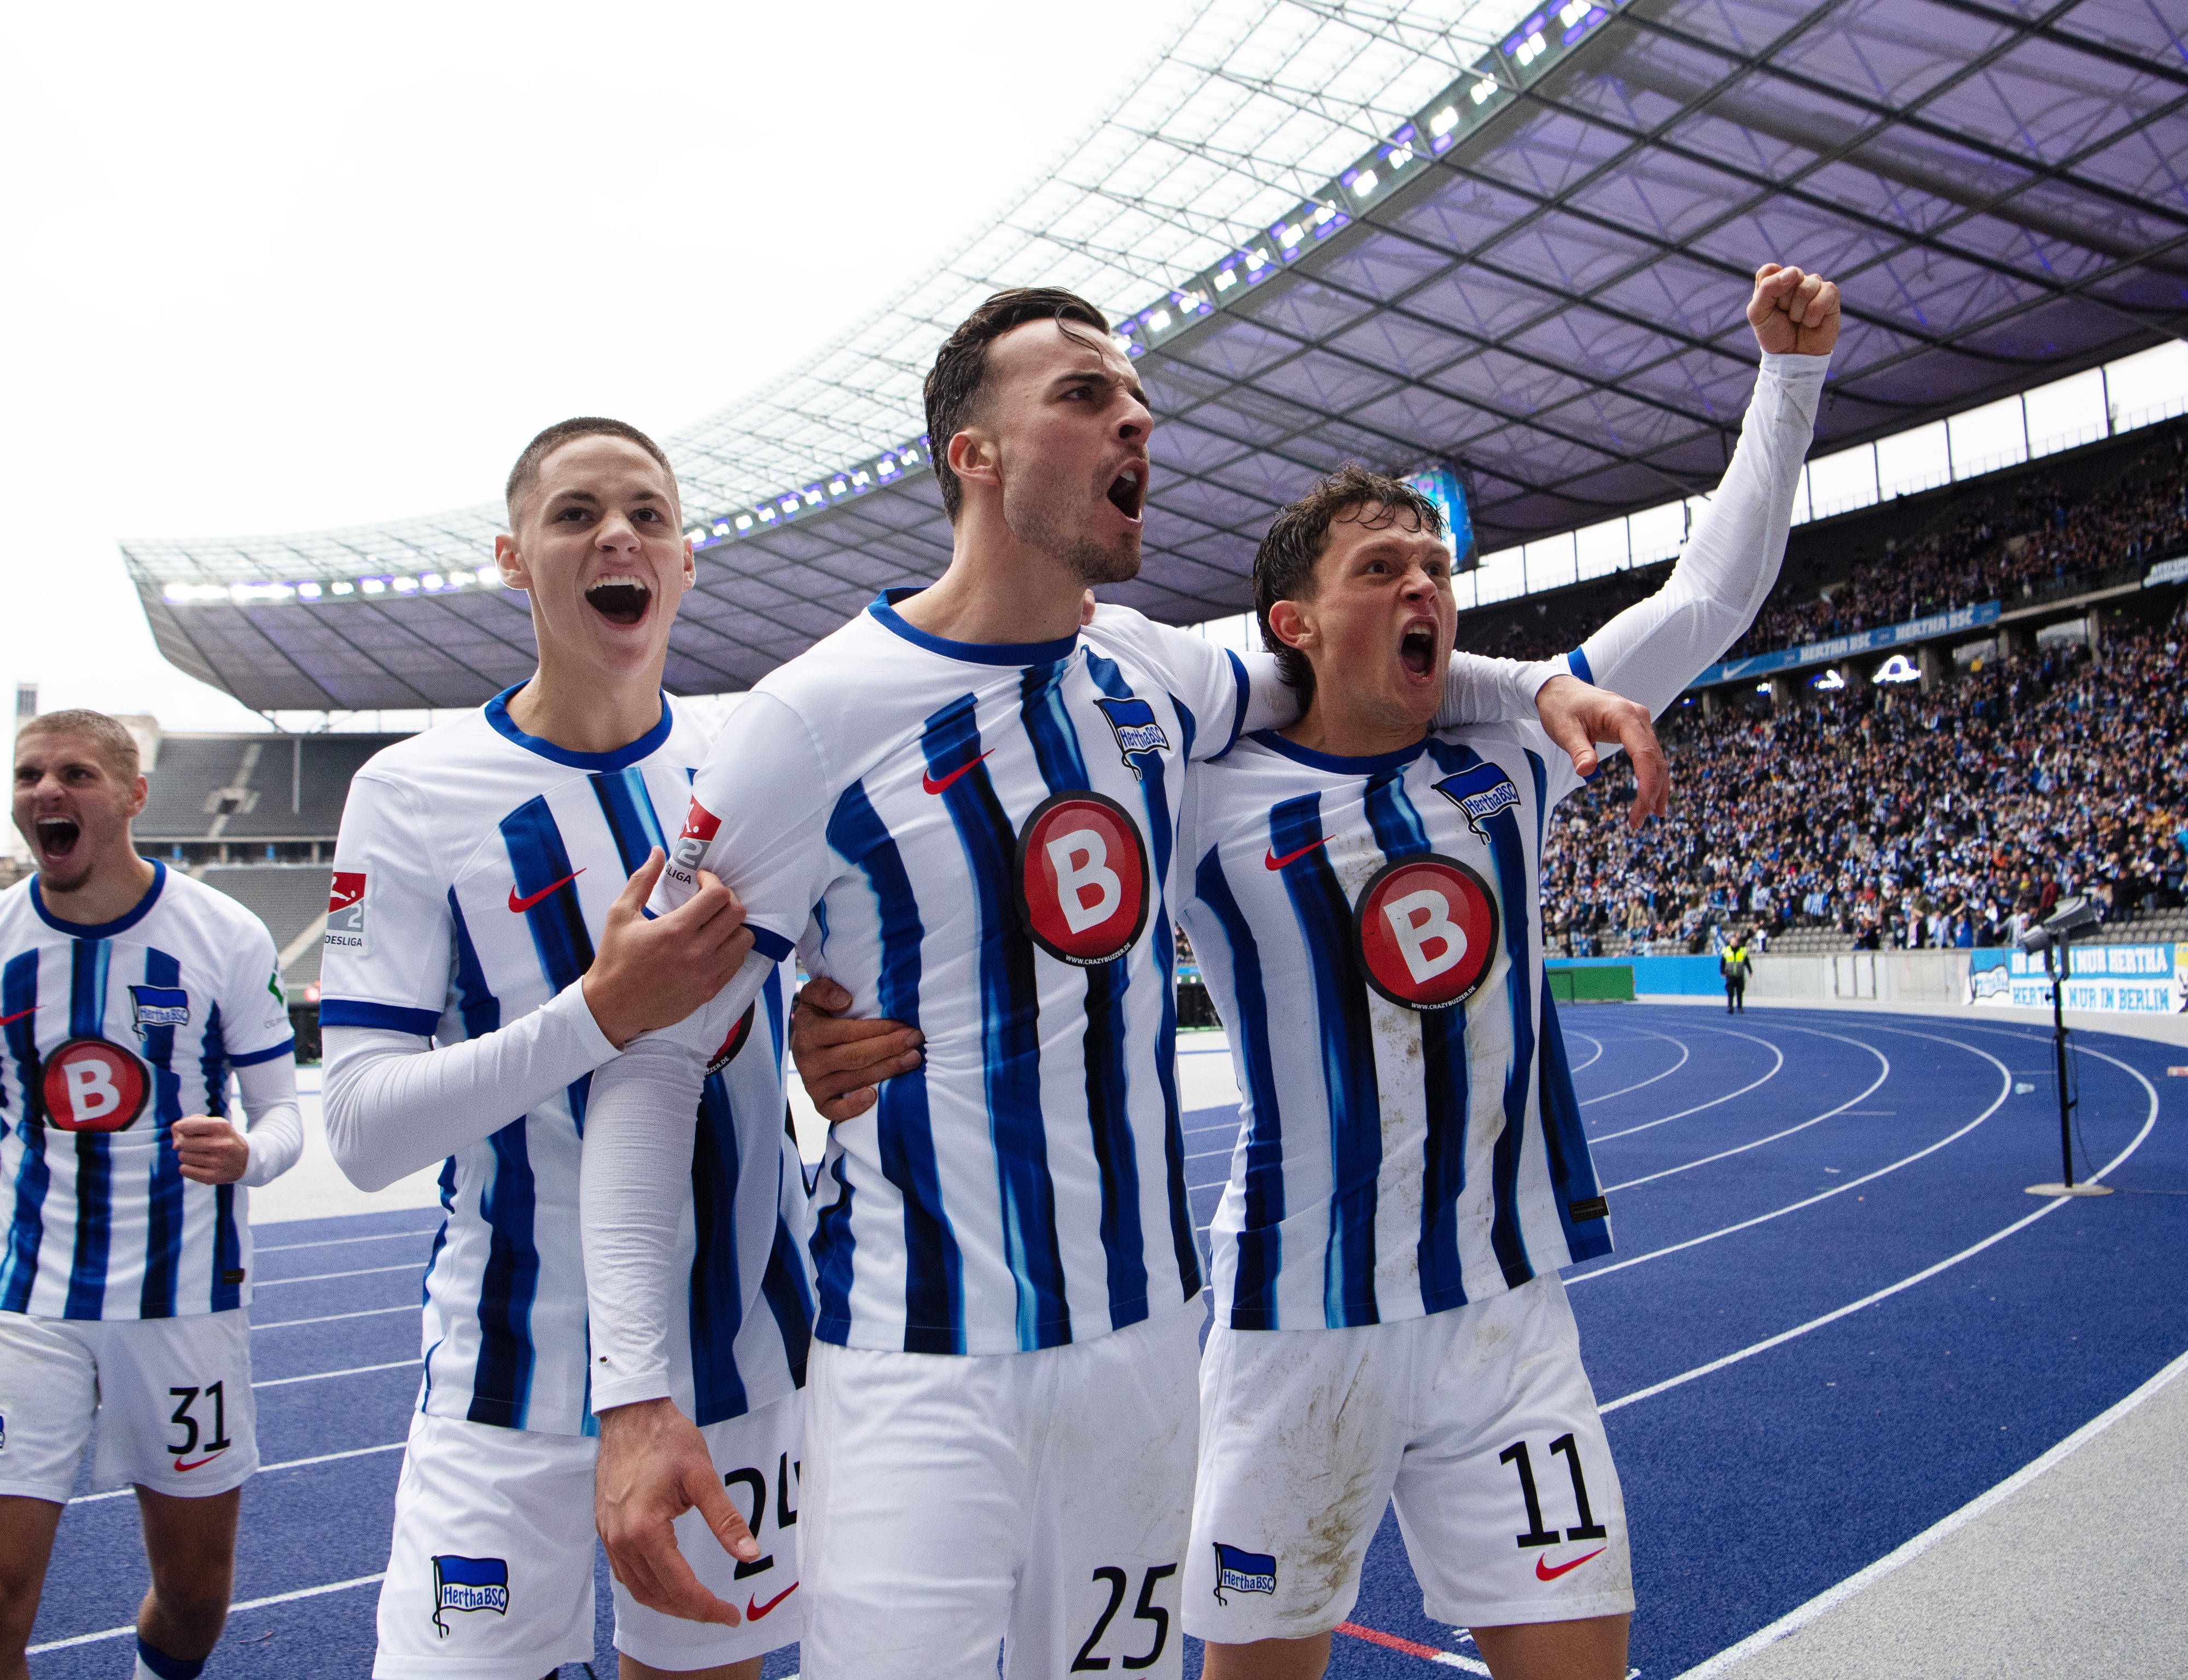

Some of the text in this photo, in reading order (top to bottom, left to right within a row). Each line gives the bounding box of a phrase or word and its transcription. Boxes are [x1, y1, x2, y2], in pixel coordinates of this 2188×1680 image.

[1895, 616, 1947, 641] HERTHA
[677, 839, 703, 866] 2
[1046, 829, 1122, 935] B
[347, 902, 362, 928] 2
[1383, 889, 1468, 984] B
[1066, 942, 1132, 965] WWW.CRAZYBUZZER.DE
[2076, 948, 2106, 973] NUR
[2108, 947, 2168, 973] HERTHA
[1411, 985, 1476, 1010] WWW.CRAZYBUZZER.DE
[2069, 987, 2097, 1008] NUR
[2101, 988, 2114, 1008] IN
[2119, 988, 2169, 1011] BERLIN
[62, 1059, 121, 1123] B
[167, 1380, 231, 1455] 31
[1499, 1433, 1607, 1548] 11
[1070, 1562, 1178, 1673] 25
